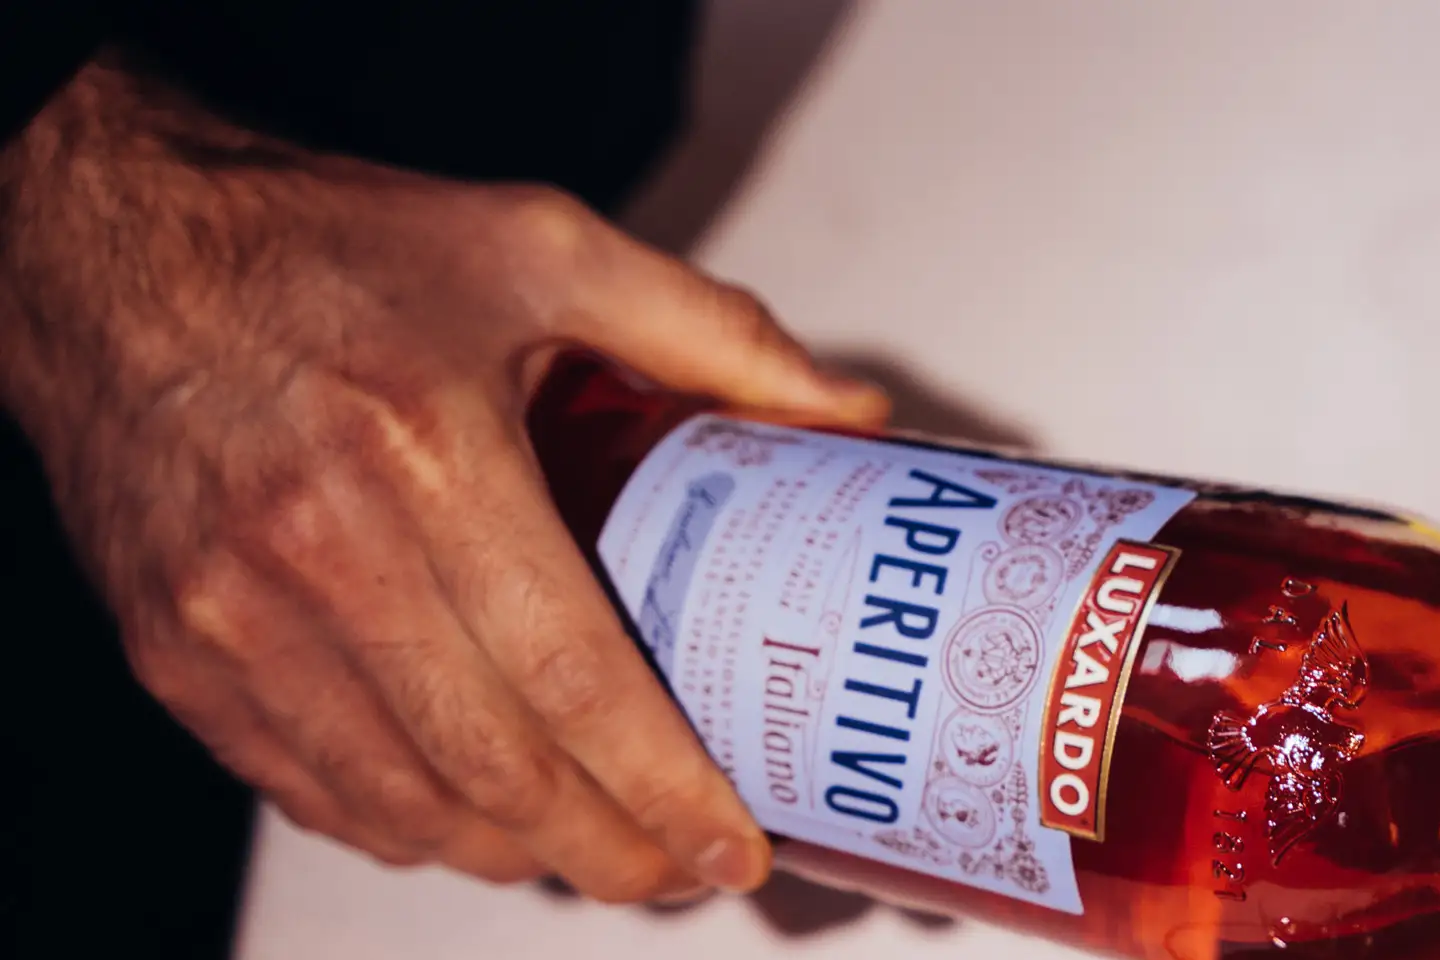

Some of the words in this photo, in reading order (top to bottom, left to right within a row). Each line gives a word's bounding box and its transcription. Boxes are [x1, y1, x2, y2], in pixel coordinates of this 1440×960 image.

[763, 635, 821, 804] Italiano
[824, 468, 998, 826] APERITIVO
[1048, 551, 1158, 818] LUXARDO
